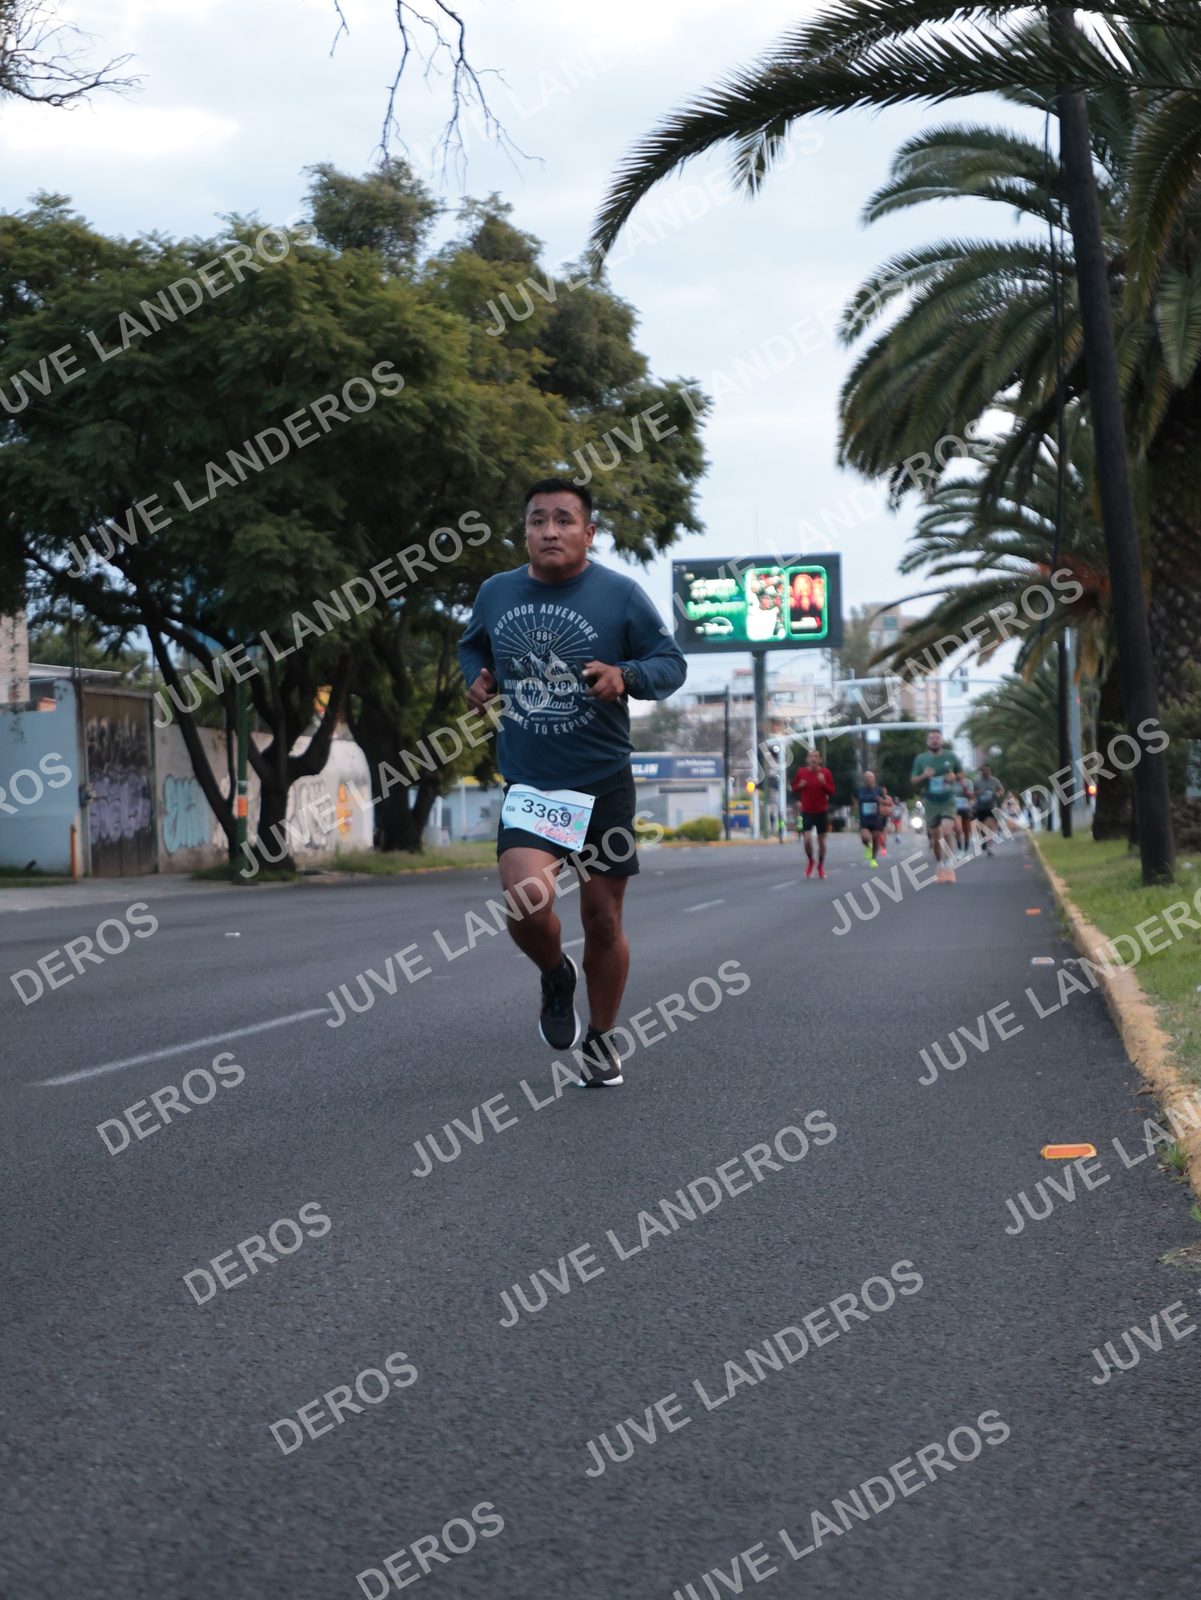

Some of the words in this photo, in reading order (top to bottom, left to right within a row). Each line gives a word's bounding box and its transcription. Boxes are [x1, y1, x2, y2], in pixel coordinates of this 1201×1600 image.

[494, 603, 535, 636] OUTDOOR
[539, 603, 599, 641] ADVENTURE
[519, 690, 575, 711] Wildland
[534, 723, 548, 735] TO
[553, 707, 598, 735] EXPLORE
[521, 799, 572, 827] 3369
